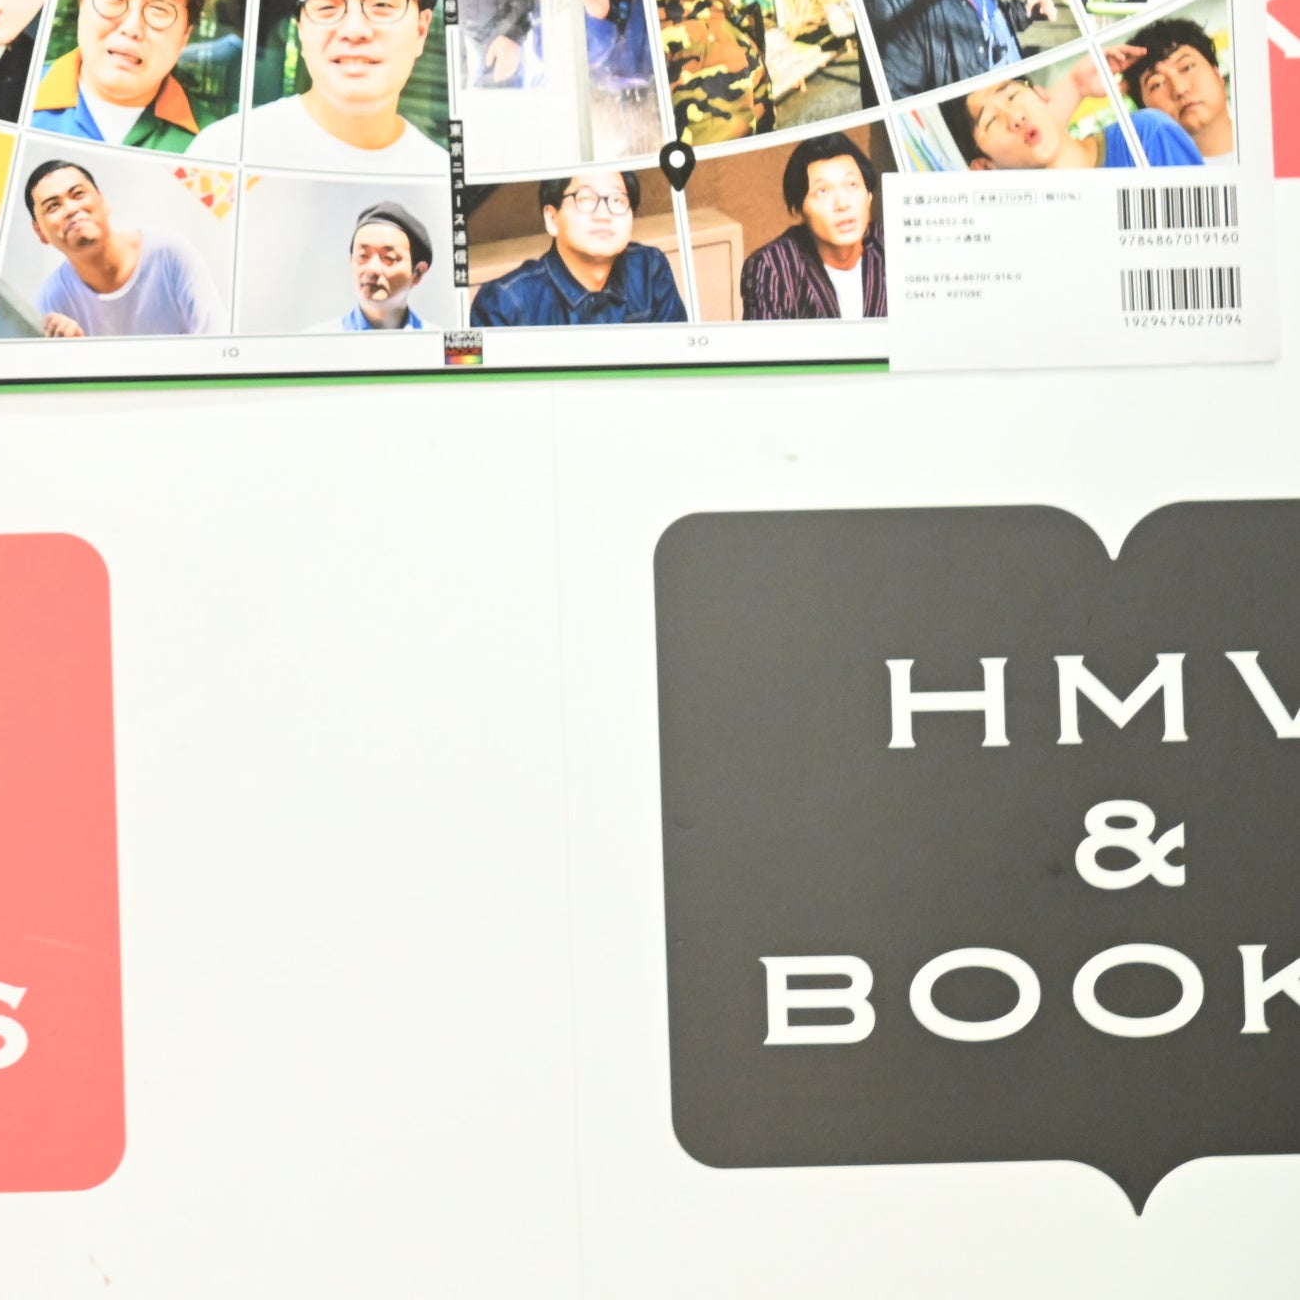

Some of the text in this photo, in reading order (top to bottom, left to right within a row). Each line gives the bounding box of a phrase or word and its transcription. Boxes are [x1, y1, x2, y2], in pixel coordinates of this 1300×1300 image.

[449, 122, 469, 286] 東京ニュース通信社
[885, 650, 1300, 749] HMV
[1074, 799, 1186, 890] &
